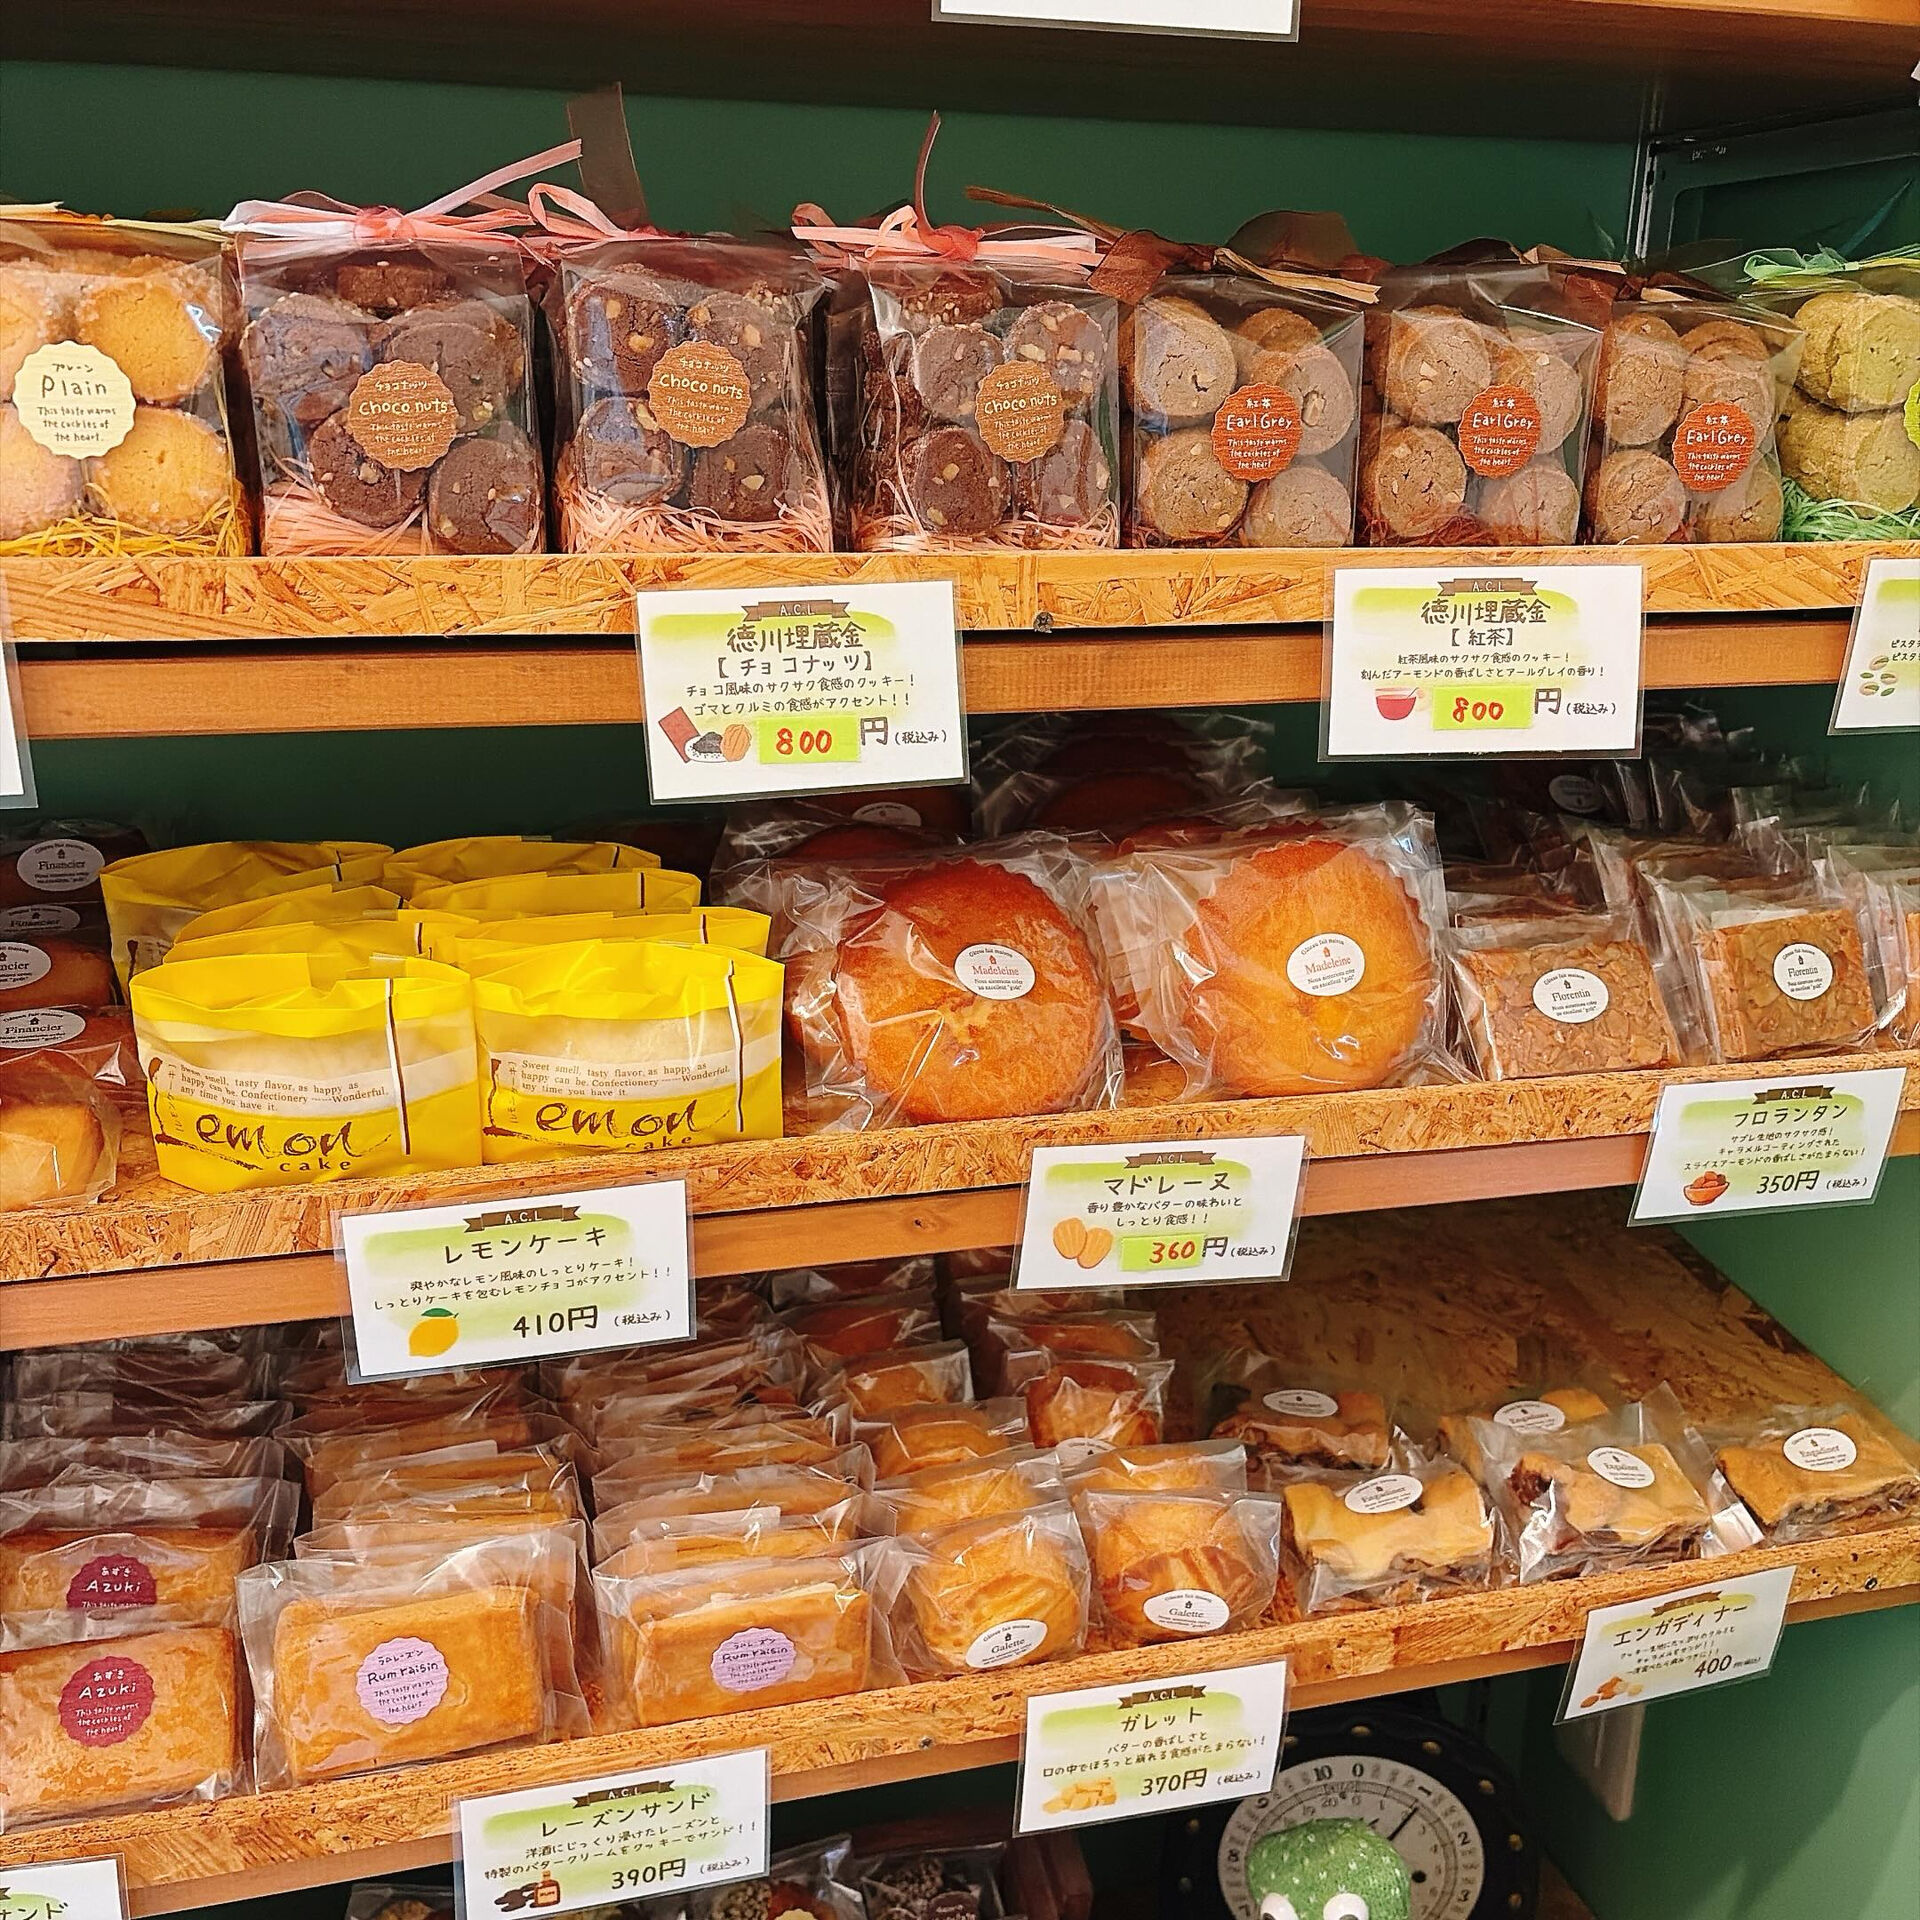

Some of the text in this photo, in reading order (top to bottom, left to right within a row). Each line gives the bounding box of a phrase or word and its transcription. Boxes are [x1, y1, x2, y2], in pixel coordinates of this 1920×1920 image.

[52, 363, 93, 373] プレーン
[41, 375, 107, 398] Plain
[659, 374, 743, 399] Choco nuts
[358, 398, 448, 416] Choco nuts
[984, 393, 1057, 415] Choco nuts
[1246, 398, 1271, 408] 紅茶
[1492, 397, 1515, 408] 紅茶
[1226, 412, 1292, 430] Earl Grey
[1473, 412, 1533, 430] Earl Grey
[1706, 415, 1729, 425] 紅茶
[1687, 429, 1747, 445] Earl Grey
[1472, 581, 1505, 592] A.C.L
[778, 603, 814, 616] A.C.L
[1420, 599, 1551, 625] 徳川埋蔵金
[726, 621, 866, 653] 徳川埋蔵金
[1451, 627, 1514, 647] 【紅茶】
[717, 651, 872, 679] 【チョコナッツ】
[1397, 652, 1569, 665] 紅茶風味のサクサク食感のクッキー！
[1360, 666, 1605, 680] 刻んだアーモンドの香ばしさとアールグレイの香り！
[686, 674, 915, 697] チョコ風味のサクサク食感のクッキー！
[693, 694, 910, 717] ゴマとクルミの食感がアクセント！！
[1452, 687, 1616, 723] 800 円 （税込み）
[776, 716, 947, 755] 800 円 （税込み）
[38, 861, 86, 870] Financier
[972, 965, 1019, 976] Madeleine
[1304, 956, 1351, 976] Madeleine
[1787, 966, 1818, 978] Florentin
[1551, 989, 1591, 1002] Florentin
[5, 1024, 63, 1034] Financier
[521, 1059, 550, 1071] Sweet
[555, 1065, 580, 1076] smell,
[587, 1067, 608, 1078] tasty
[663, 1064, 691, 1075] happy
[697, 1062, 706, 1070] as
[521, 1070, 550, 1083] happy
[554, 1075, 570, 1084] can
[180, 1073, 206, 1088] happy
[235, 1078, 259, 1090] tasty
[298, 1083, 308, 1092] as
[313, 1084, 342, 1096] happy
[348, 1082, 359, 1090] as
[180, 1085, 195, 1097] any
[200, 1090, 218, 1101] time
[222, 1095, 236, 1106] you
[240, 1101, 262, 1110] have
[542, 1084, 563, 1094] time
[567, 1089, 587, 1097] you
[590, 1088, 614, 1097] have
[1735, 1104, 1848, 1128] フロランタン
[625, 1135, 692, 1151] cake
[1731, 1127, 1833, 1143] サブレ生地のサクサク感！
[1719, 1138, 1840, 1155] キャラメルコーティングされた
[279, 1157, 352, 1173] cake
[1104, 1172, 1230, 1196] マドレーヌ
[1756, 1170, 1820, 1194] 350円
[1087, 1197, 1242, 1214] 香り豊かなバターの味わいと
[504, 1212, 542, 1225] A.C.L
[1116, 1213, 1208, 1228] しっとり食感！！
[445, 1227, 607, 1265] レモンケーキ
[1149, 1240, 1195, 1264] 360
[1202, 1235, 1229, 1258] 円
[410, 1256, 634, 1292] 爽やかなレモン風味のしっとりケーキ！
[374, 1266, 671, 1310] しっとりケーキを包むレモンチョコがアクセント！！
[512, 1304, 671, 1338] 410円 （税込み）
[101, 1565, 131, 1577] あずき
[85, 1580, 141, 1593] Azuki
[1168, 1607, 1204, 1618] Galette
[1613, 1605, 1748, 1647] エンガディナー
[991, 1637, 1025, 1654] Galette
[378, 1649, 424, 1665] ラムレーズン
[722, 1647, 788, 1663] Rum raisin
[367, 1662, 439, 1685] Rum raisin
[1694, 1654, 1732, 1678] 400
[93, 1669, 125, 1682] あずき
[79, 1682, 137, 1699] Azuki
[1120, 1706, 1202, 1733] ガレット
[1107, 1731, 1208, 1754] バターの香ばしさと
[1314, 1764, 1333, 1781] 10
[1352, 1763, 1364, 1777] 0
[1140, 1767, 1208, 1796] 370円
[542, 1791, 710, 1837] レーズンサンド
[525, 1815, 720, 1859] 洋酒にじっくり浸けたレーズンと
[1457, 1831, 1471, 1846] 2
[611, 1857, 686, 1890] 390円
